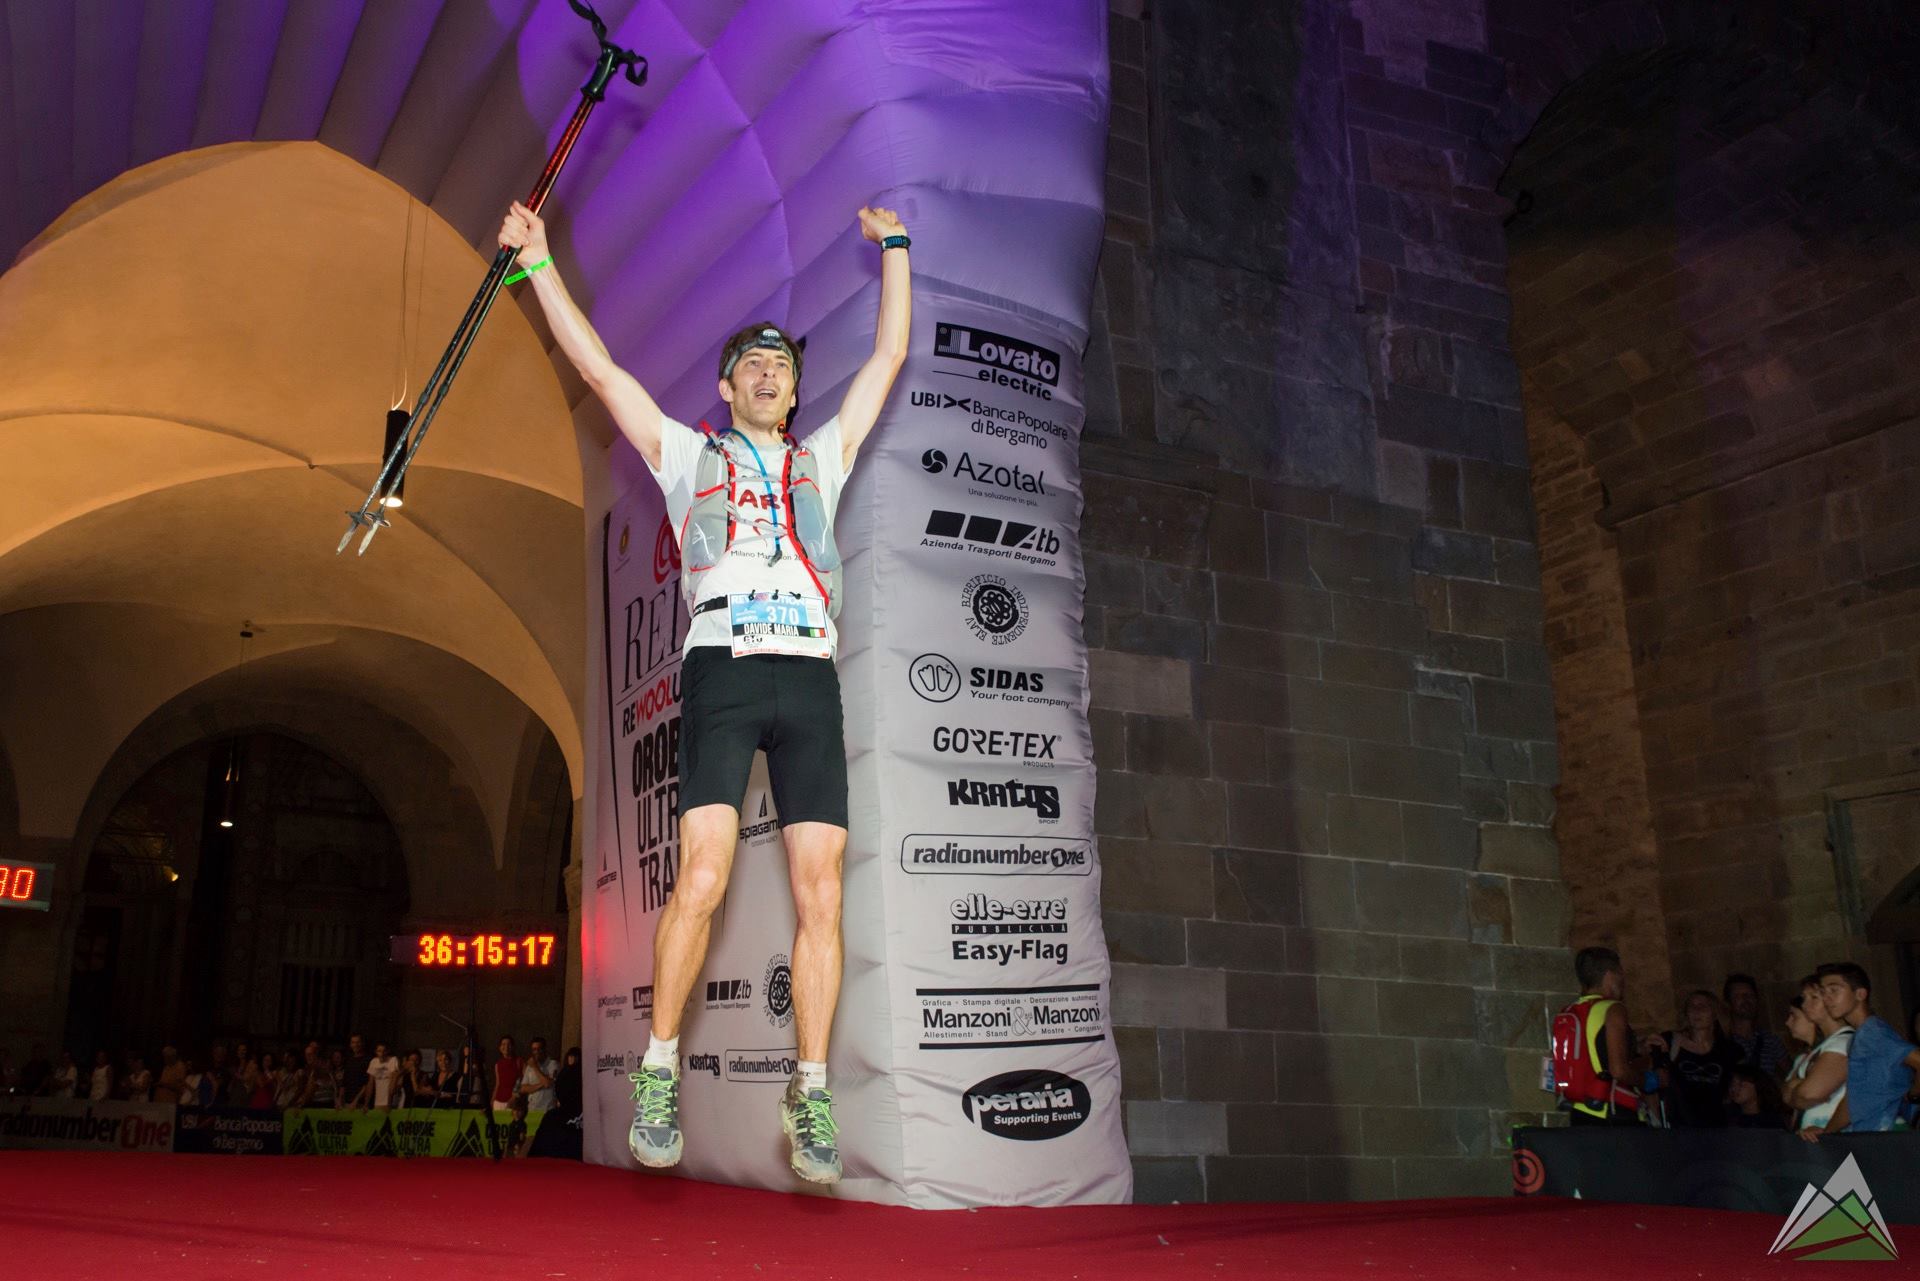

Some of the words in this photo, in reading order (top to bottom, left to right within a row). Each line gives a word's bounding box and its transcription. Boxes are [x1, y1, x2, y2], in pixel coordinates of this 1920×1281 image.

[959, 330, 1058, 381] Lovato
[978, 368, 1052, 401] electric
[911, 391, 941, 408] UBI
[973, 400, 1016, 423] Banca
[1017, 410, 1068, 441] Popolare
[971, 419, 984, 433] di
[986, 420, 1048, 450] Bergamo
[953, 451, 1046, 495] Azotal
[968, 488, 983, 497] Una
[730, 550, 755, 558] Milano
[920, 538, 964, 551] Azienda
[967, 543, 1012, 559] Trasporti
[1014, 551, 1057, 567] Bergamo
[961, 574, 1007, 608] BIRRIFICIO
[766, 605, 800, 626] 370
[991, 585, 1030, 646] INDIPENDENTE
[743, 623, 773, 635] DAVIDE
[773, 624, 799, 637] MARIA
[965, 617, 988, 642] ELAV
[970, 667, 1044, 692] SIDAS
[970, 690, 999, 700] Your
[1000, 692, 1025, 702] foot
[1027, 696, 1071, 709] company
[632, 716, 681, 798] OROB
[1023, 760, 1055, 768] PRODUCTS
[637, 782, 679, 854] ULTR
[913, 842, 1086, 868] radionumberOne
[950, 893, 1066, 920] elle-erre
[419, 935, 555, 965] 36:15:17
[952, 939, 1068, 966] Easy-Flag
[922, 999, 952, 1007] Grafica
[962, 999, 991, 1007] Stampa
[994, 998, 1021, 1007] digitale
[1029, 996, 1069, 1004] Decorazione
[922, 1007, 1011, 1029] Manzoni
[1011, 1006, 1037, 1036] &
[1033, 1002, 1100, 1026] Manzoni
[986, 1030, 1008, 1038] Stand
[1041, 1027, 1065, 1035] Mostre
[969, 1083, 1074, 1129] peraria
[993, 1114, 1050, 1126] Supporting
[1051, 1111, 1082, 1122] Events
